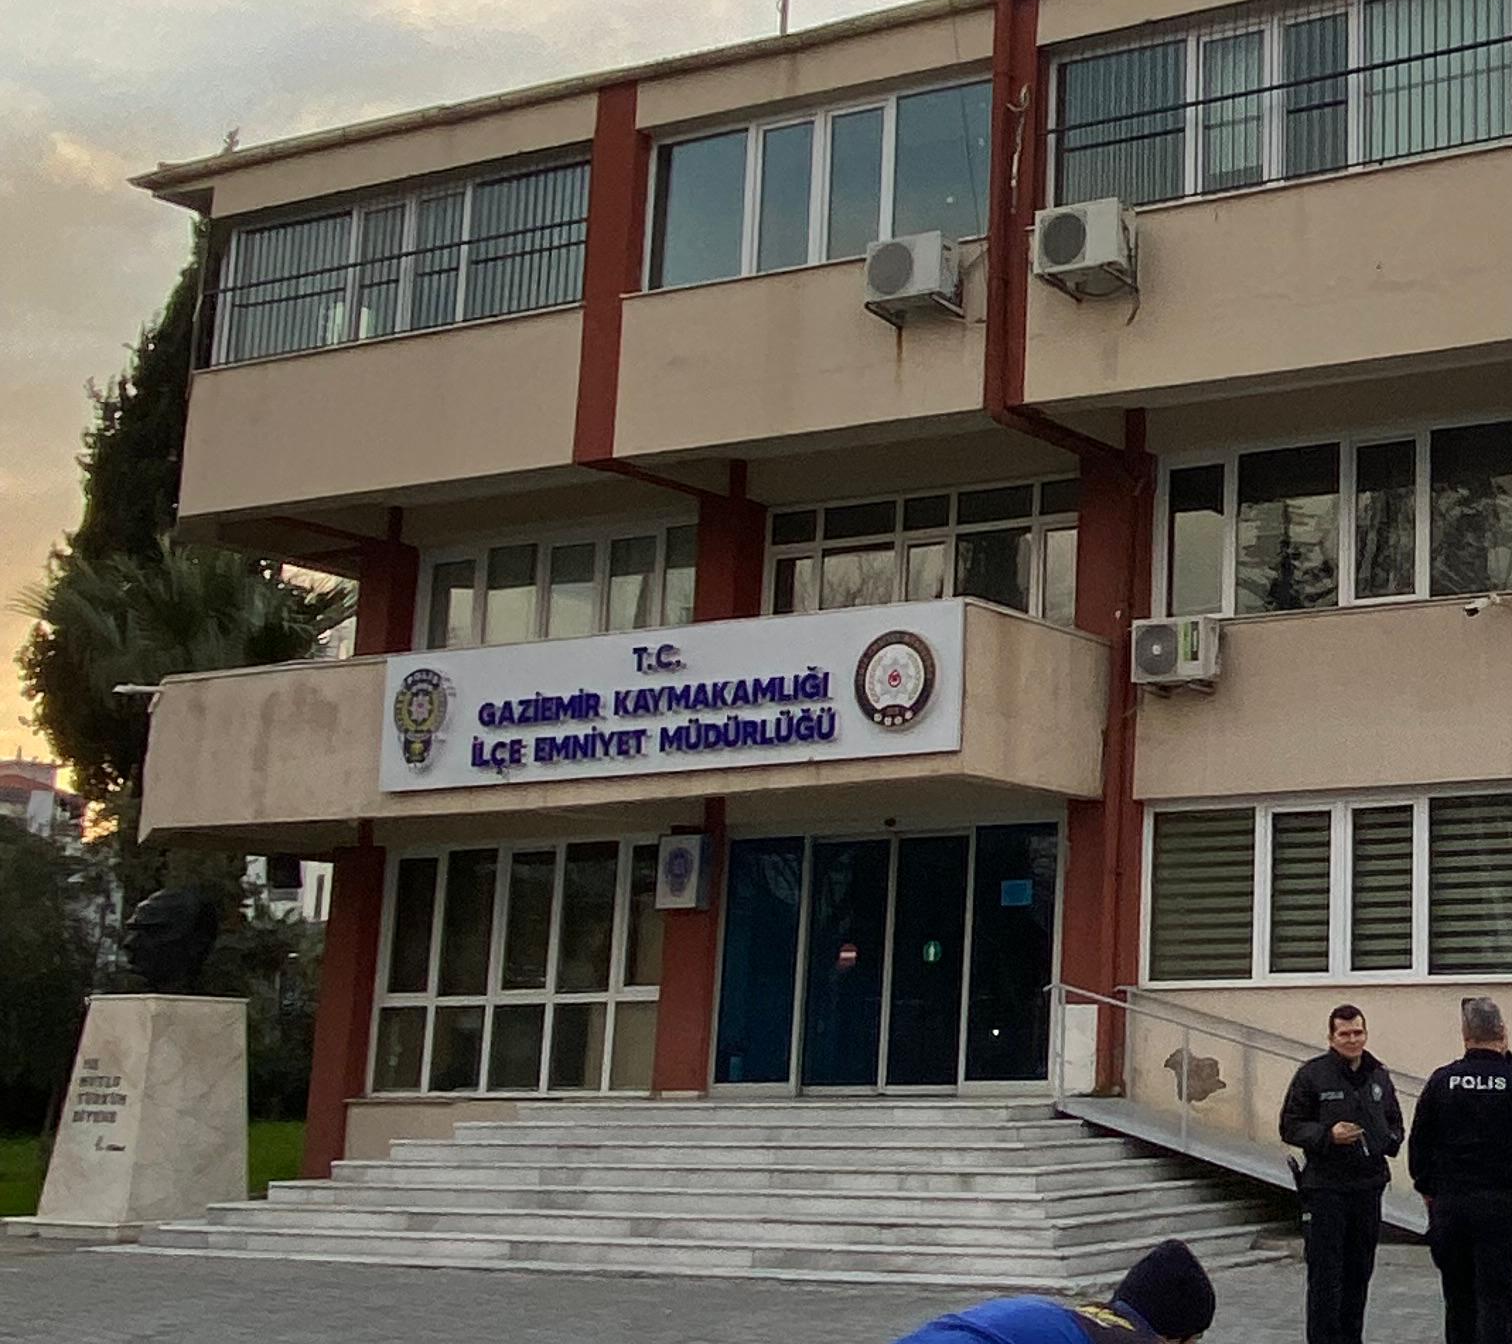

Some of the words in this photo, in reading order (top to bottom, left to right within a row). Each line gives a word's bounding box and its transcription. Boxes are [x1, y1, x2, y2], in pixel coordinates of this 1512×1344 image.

[633, 644, 681, 672] T.C.
[478, 688, 601, 727] GAZİEMİR
[613, 666, 830, 716] KAYMAKAMLIĞI
[471, 736, 523, 775] İLÇE
[533, 725, 647, 762] EMNİYET
[659, 706, 836, 753] MÜDÜRLÜĞÜ
